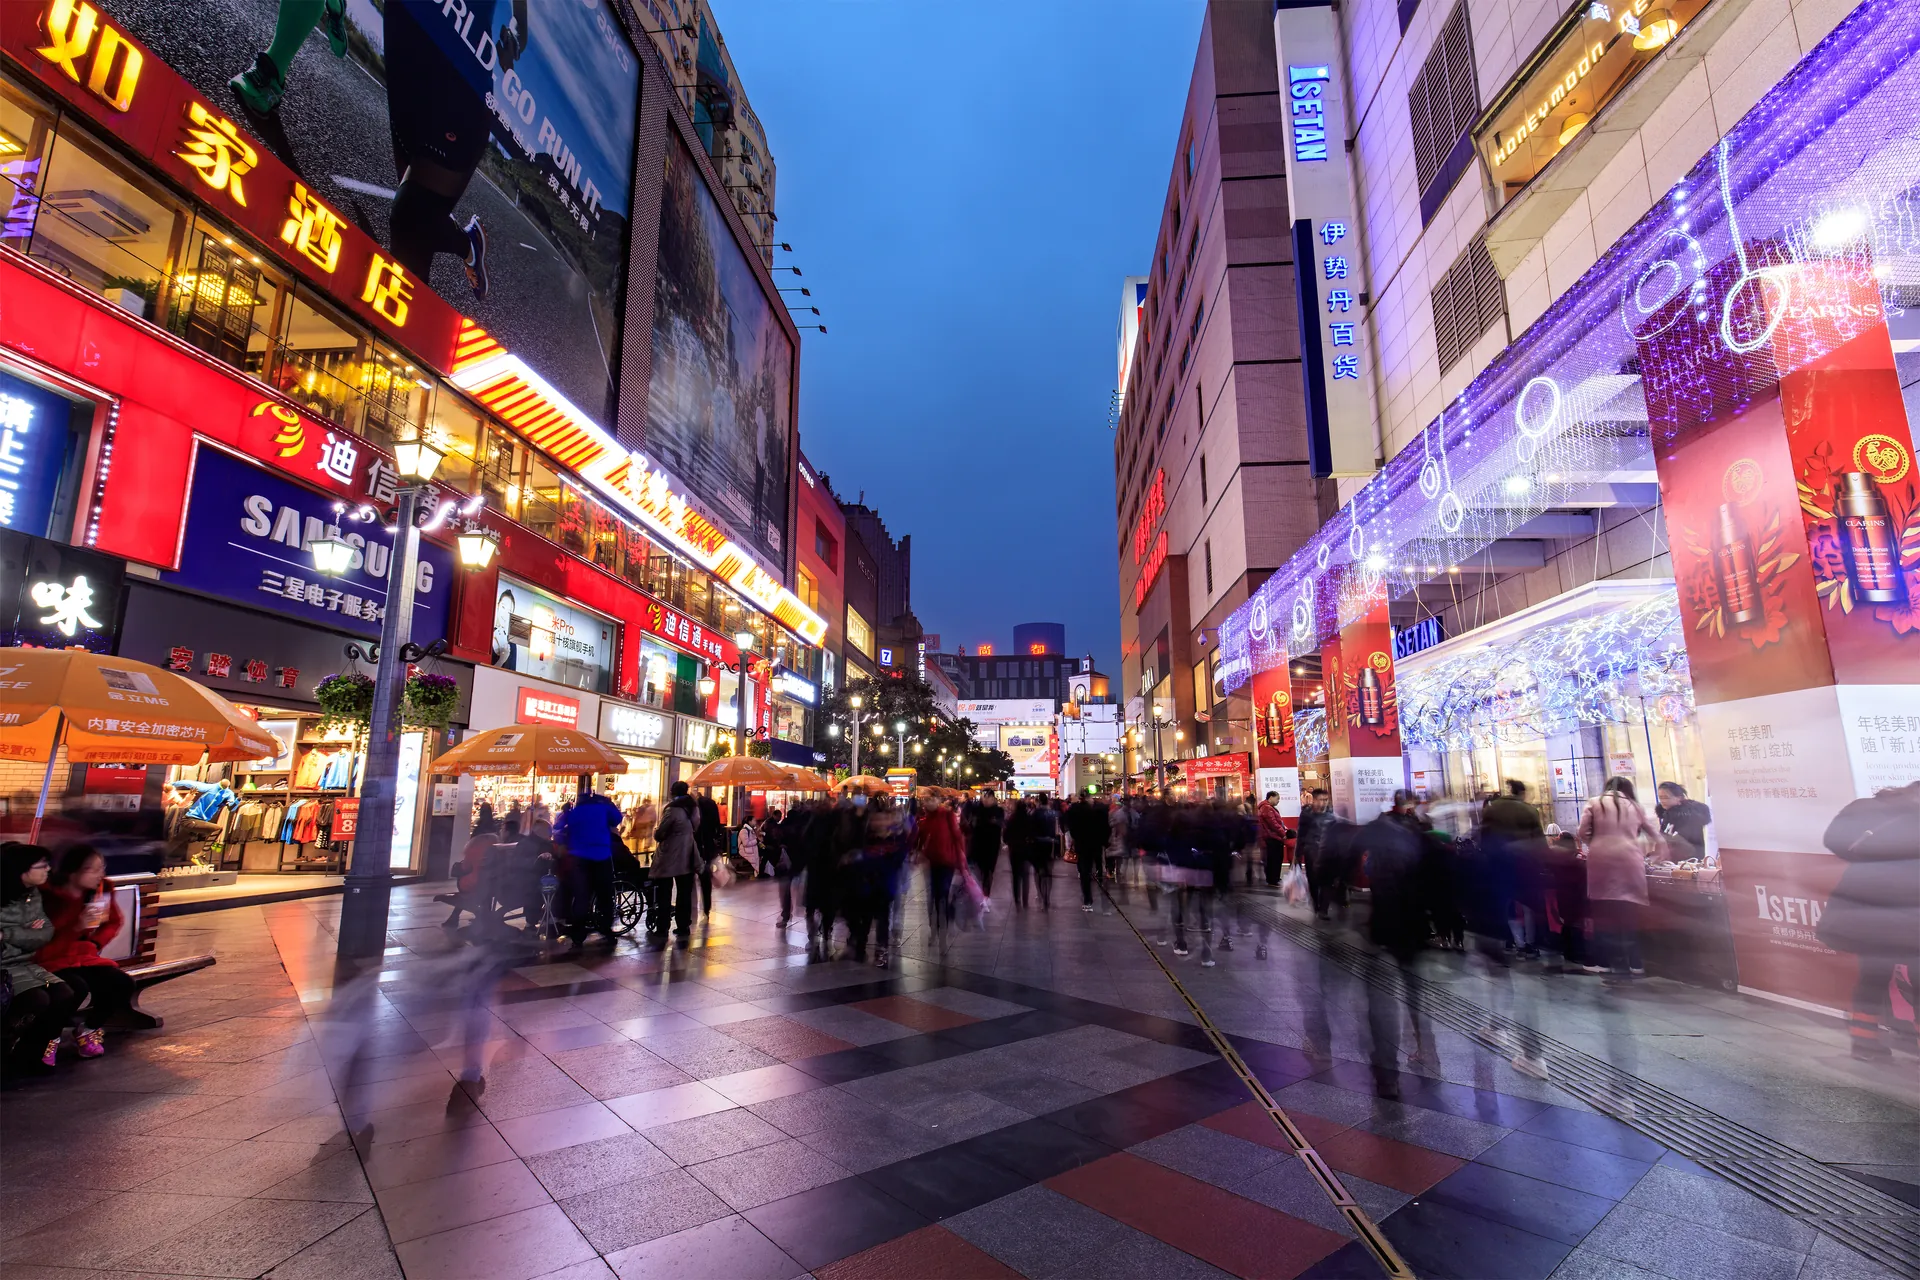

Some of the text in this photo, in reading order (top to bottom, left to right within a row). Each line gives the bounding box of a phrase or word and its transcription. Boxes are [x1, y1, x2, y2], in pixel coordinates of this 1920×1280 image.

[432, 0, 498, 82] RLD.
[502, 68, 536, 126] GO
[537, 116, 583, 190] RUN
[1289, 64, 1329, 161] ISETAN
[37, 0, 415, 328] 如家酒店
[1320, 222, 1360, 381] 伊势丹百货
[240, 494, 434, 594] SAMSUG
[31, 575, 103, 637] 味
[664, 611, 702, 649] 迪信通
[164, 646, 300, 691] 安踏体育
[107, 691, 170, 706] 金立M6
[87, 717, 208, 740] 内置安全加密芯片
[1728, 724, 1775, 742] 年轻美肌
[1857, 715, 1920, 733] 年轻美肌
[1860, 736, 1920, 754] 随「新」
[1357, 769, 1384, 777] 年轻美肌
[1888, 772, 1905, 781] skin
[1754, 884, 1828, 927] ISETA
